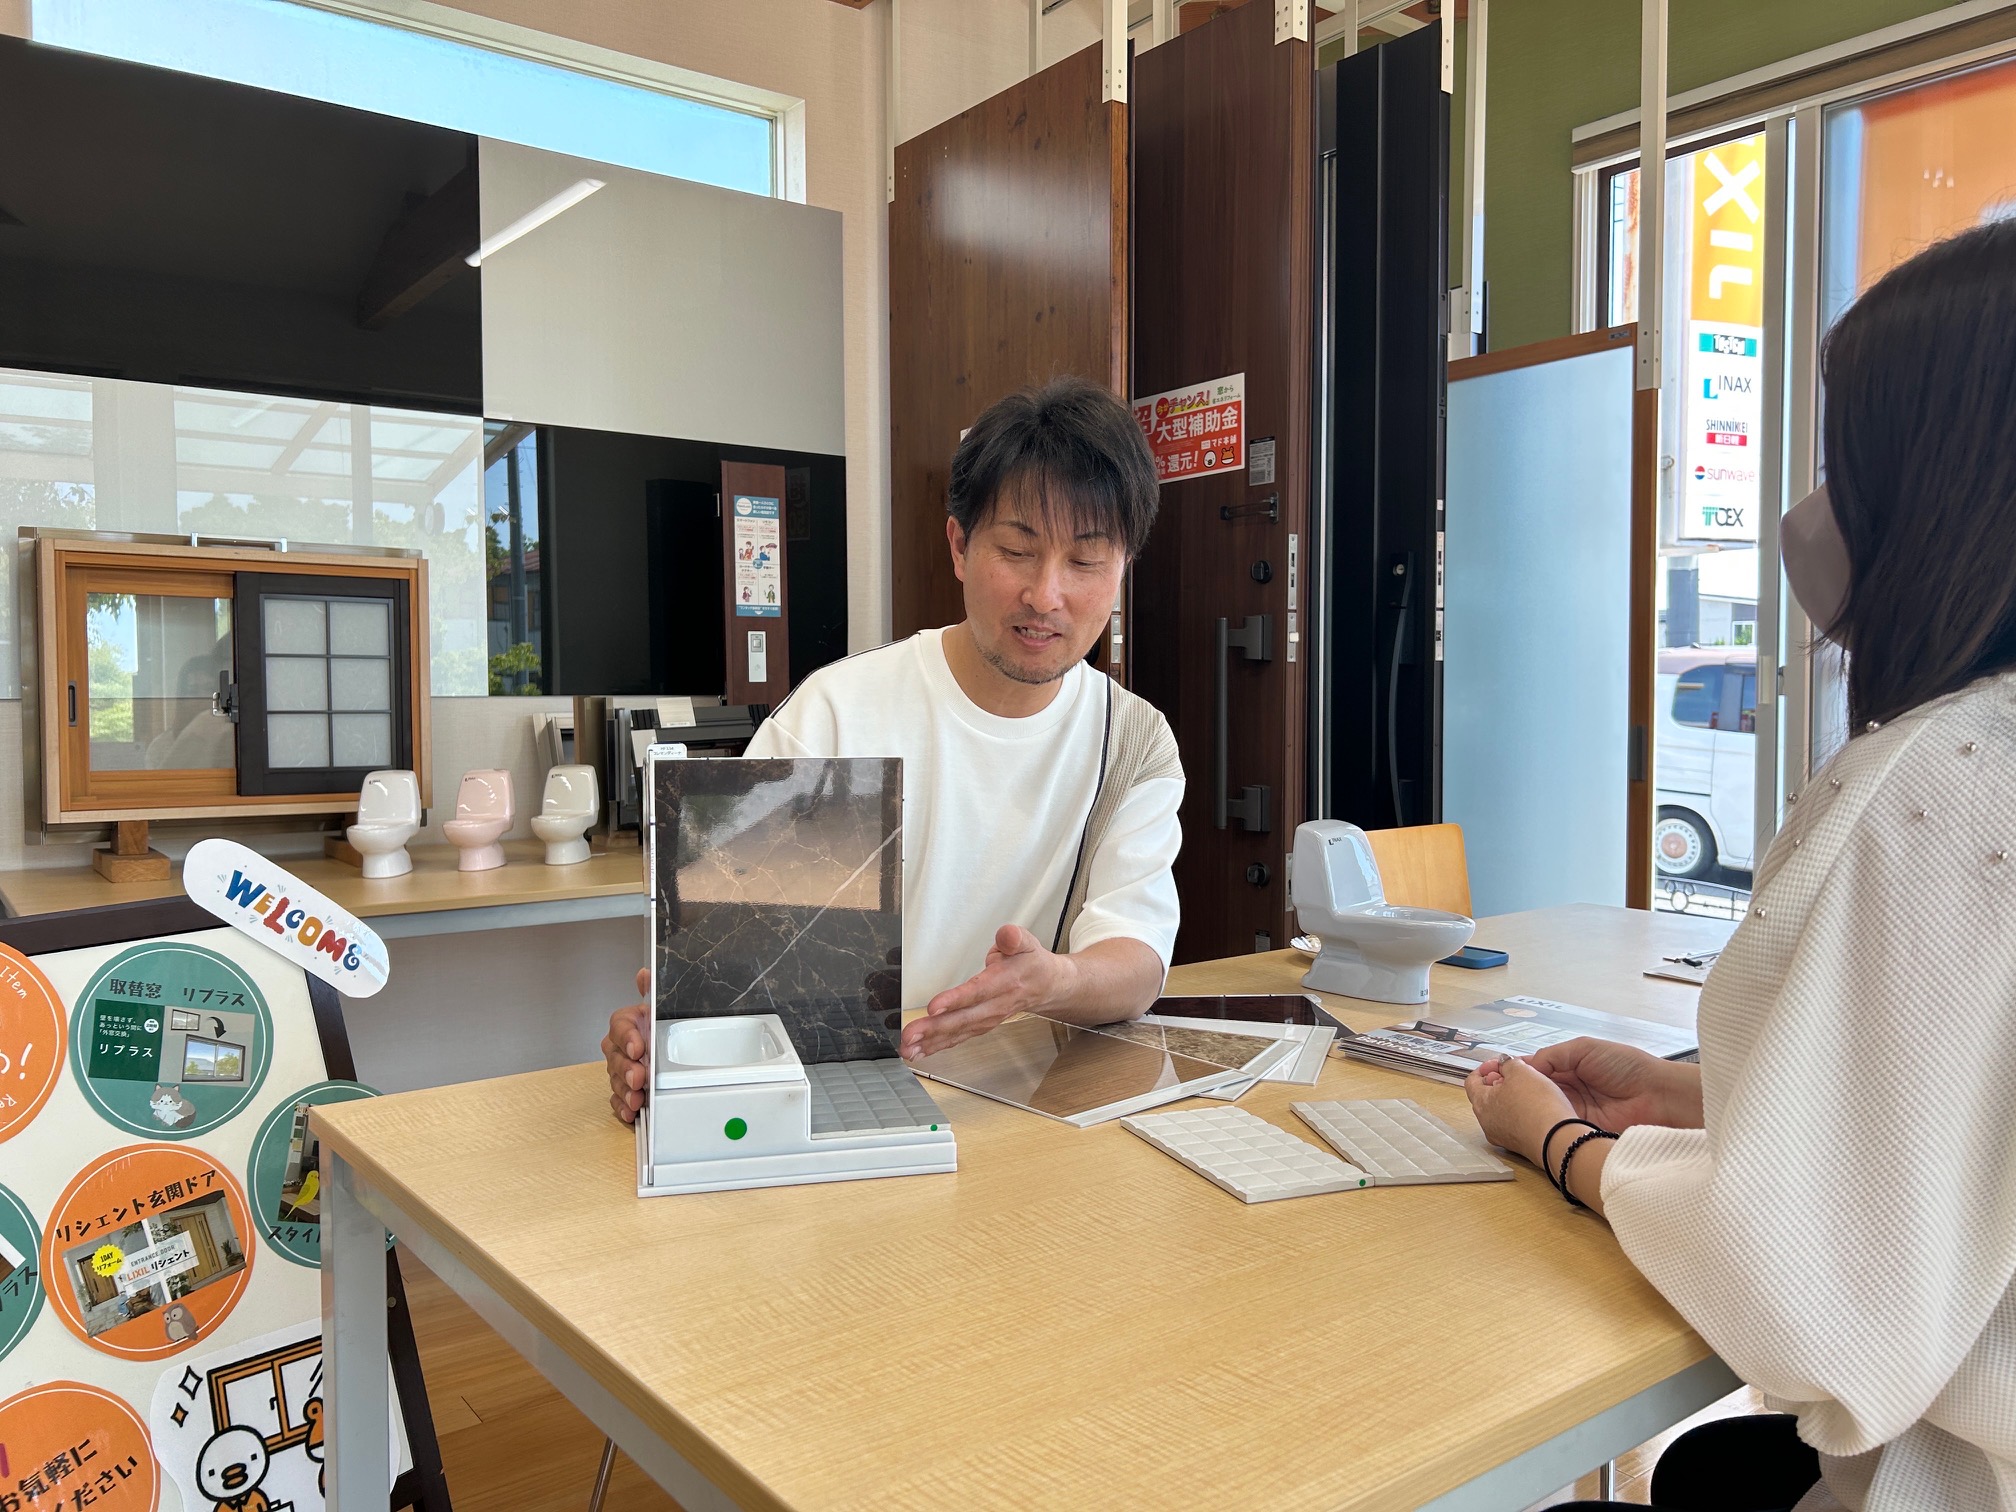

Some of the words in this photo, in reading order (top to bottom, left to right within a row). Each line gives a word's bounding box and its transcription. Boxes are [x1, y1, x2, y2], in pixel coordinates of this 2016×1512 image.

[1702, 134, 1761, 300] XIL
[1156, 406, 1238, 444] 大型補助金
[225, 870, 361, 971] WELCOME
[110, 979, 162, 999] 取替窓
[184, 987, 246, 1007] リプラス
[99, 1043, 153, 1058] リプラス
[56, 1170, 216, 1242] リシェント玄関ドア
[268, 1225, 320, 1243] スタイ
[100, 1251, 114, 1263] 1DAY
[127, 1266, 151, 1281] LIXIL
[151, 1249, 190, 1271] リシェント
[130, 1252, 159, 1267] ENTRANCE
[0, 1265, 38, 1312] ラス
